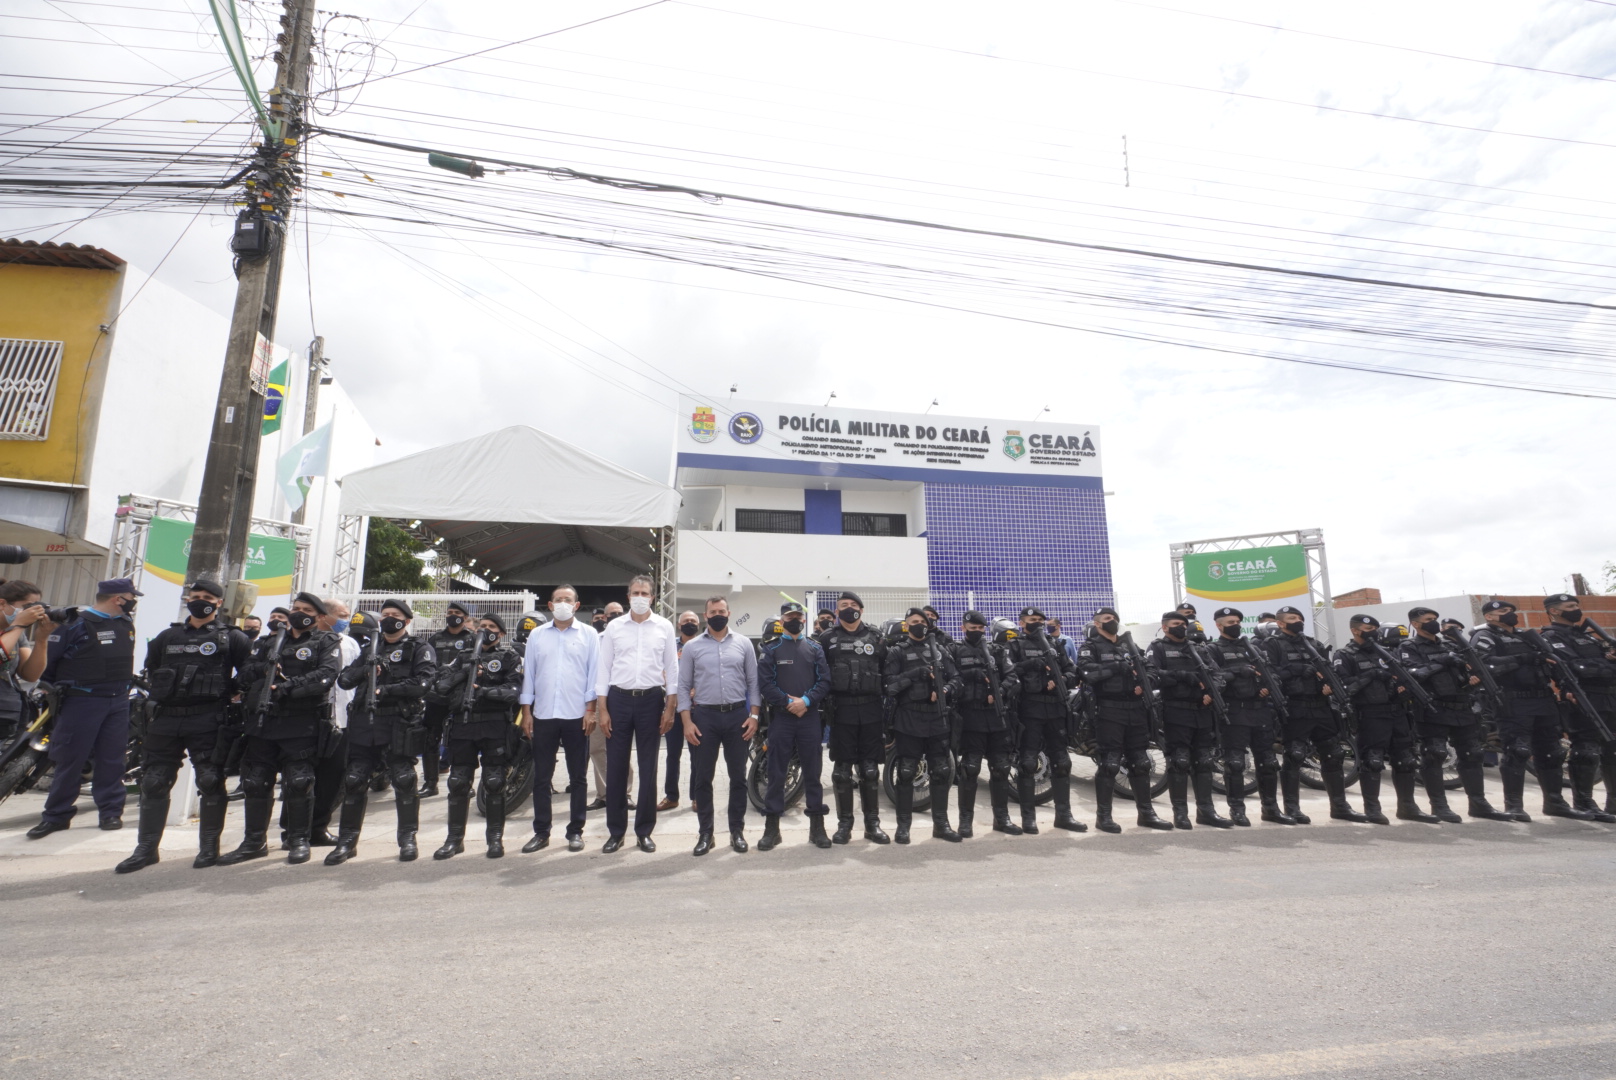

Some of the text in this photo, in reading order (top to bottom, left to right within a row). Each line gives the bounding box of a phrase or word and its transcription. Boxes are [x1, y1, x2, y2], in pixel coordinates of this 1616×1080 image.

[778, 413, 841, 434] POLÍCIA
[848, 420, 910, 439] MILITAR
[915, 425, 937, 441] DO
[942, 426, 991, 444] CEARÁ
[819, 444, 861, 452] METROPOLITANO
[1028, 431, 1096, 451] CEARÁ
[46, 544, 65, 552] 1925
[1226, 556, 1277, 572] CEARÁ
[735, 612, 751, 627] 1939
